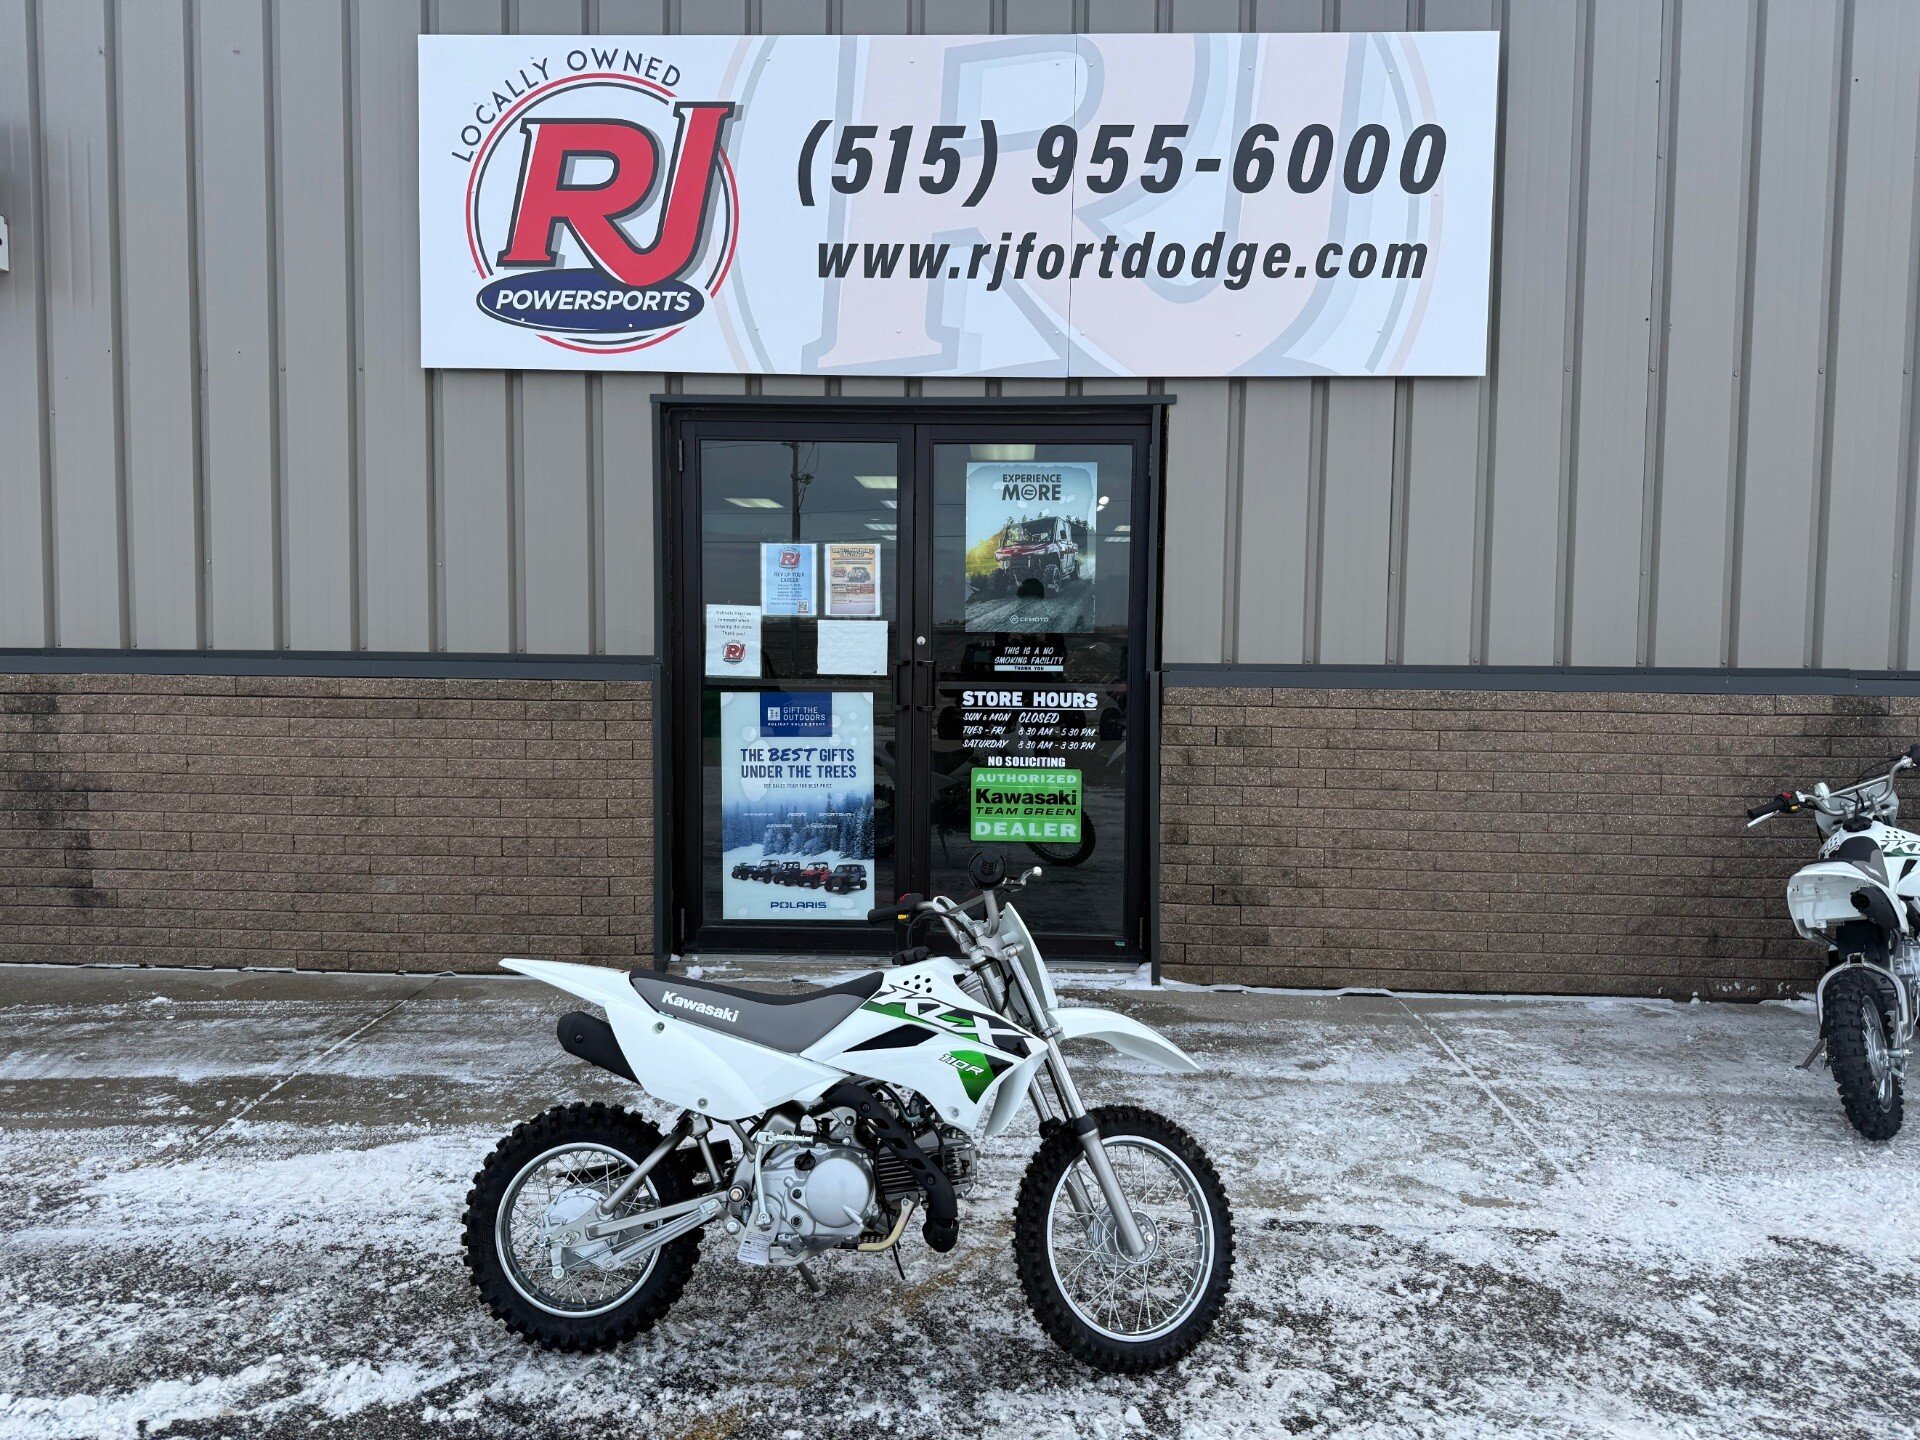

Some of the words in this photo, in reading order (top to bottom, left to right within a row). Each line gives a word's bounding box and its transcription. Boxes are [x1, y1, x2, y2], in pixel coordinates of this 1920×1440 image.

[451, 57, 550, 164] LOCALLY
[567, 47, 681, 88] OWNED
[797, 119, 998, 207] (515)
[1031, 123, 1447, 195] 955-6000
[496, 101, 738, 287] RJ
[818, 231, 1428, 291] www.rjfortdodge.com
[495, 289, 691, 313] POWERSPORTS
[1002, 473, 1062, 483] EXPERIENCE
[1004, 646, 1020, 655] THIS
[1023, 646, 1031, 655] IS
[1034, 646, 1040, 655] A
[1043, 646, 1054, 655] NO
[994, 656, 1027, 664] SMOKING
[1031, 656, 1064, 664] FACILITY
[962, 691, 1023, 707] STORE
[1033, 692, 1098, 708] HOURS
[962, 712, 982, 721] SUN
[989, 712, 1011, 722] MON
[1018, 712, 1060, 724] CLOSED
[962, 726, 984, 735] TUES
[990, 726, 1006, 735] FRI
[1037, 727, 1053, 736] AM
[1080, 728, 1096, 737] PM
[962, 739, 1009, 748] SATURDAY
[1037, 741, 1053, 749] AM
[1080, 742, 1096, 750] PM
[740, 748, 764, 762] THE
[768, 748, 818, 762] BEST
[820, 748, 855, 762] GIFTS
[987, 756, 1003, 767] NO
[1005, 756, 1066, 768] SOLICITING
[741, 765, 783, 779] UNDER
[787, 765, 812, 778] THE
[816, 765, 857, 779] TREES
[976, 773, 1077, 784] AUTHORIZED
[976, 788, 1077, 805] Kawasaki
[976, 807, 1018, 815] TEAM
[1024, 807, 1077, 816] GREEN
[975, 822, 1077, 837] DEALER
[662, 990, 740, 1022] Kawasaki
[868, 984, 1035, 1050] KLX
[938, 1053, 986, 1076] 110R
